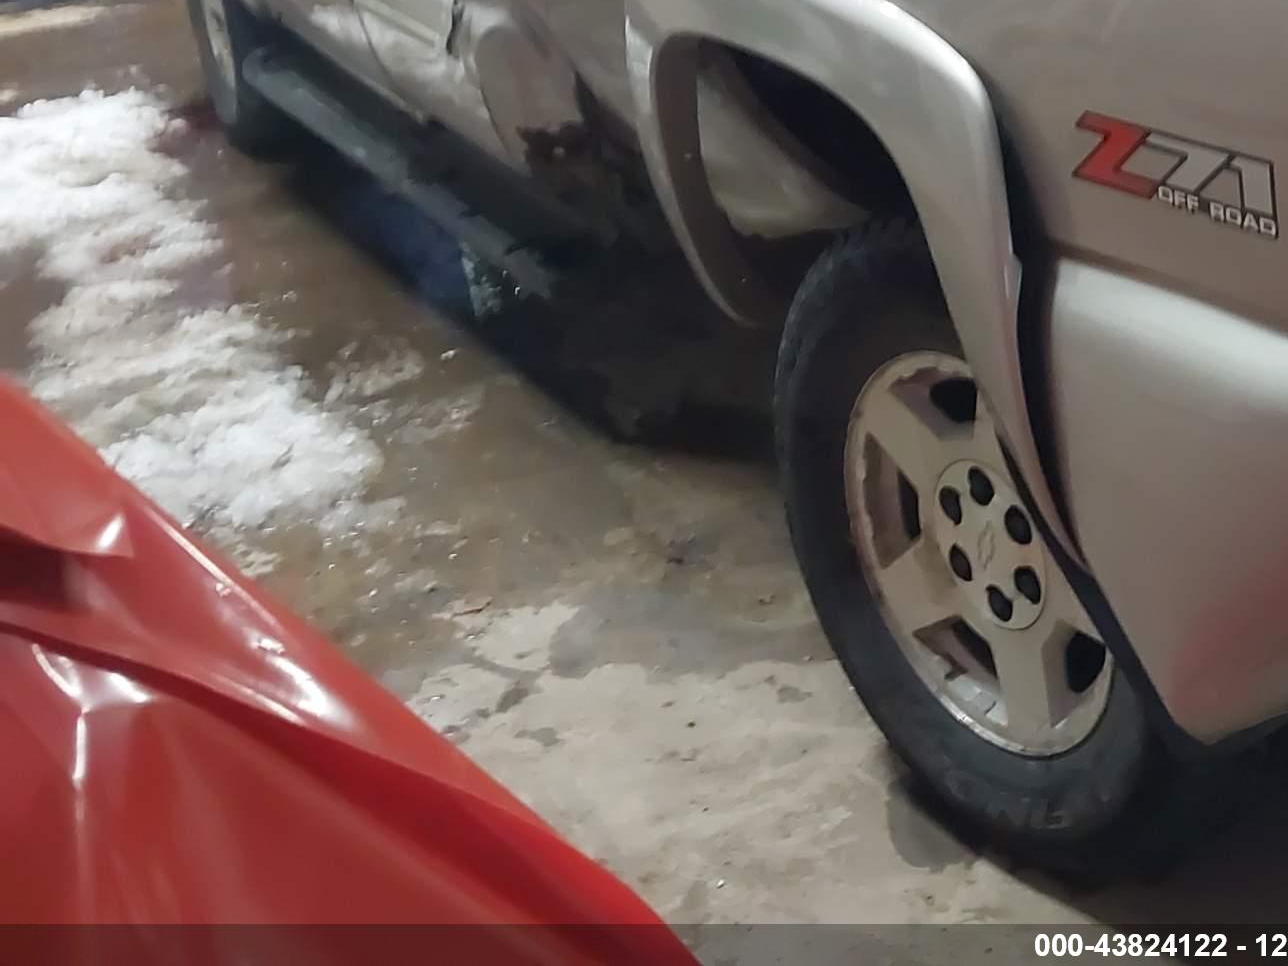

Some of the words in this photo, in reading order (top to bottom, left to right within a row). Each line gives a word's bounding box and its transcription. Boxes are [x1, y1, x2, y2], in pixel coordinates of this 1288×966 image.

[1072, 109, 1277, 220] Z71
[1157, 185, 1199, 214] OFF
[1208, 201, 1279, 239] ROAD
